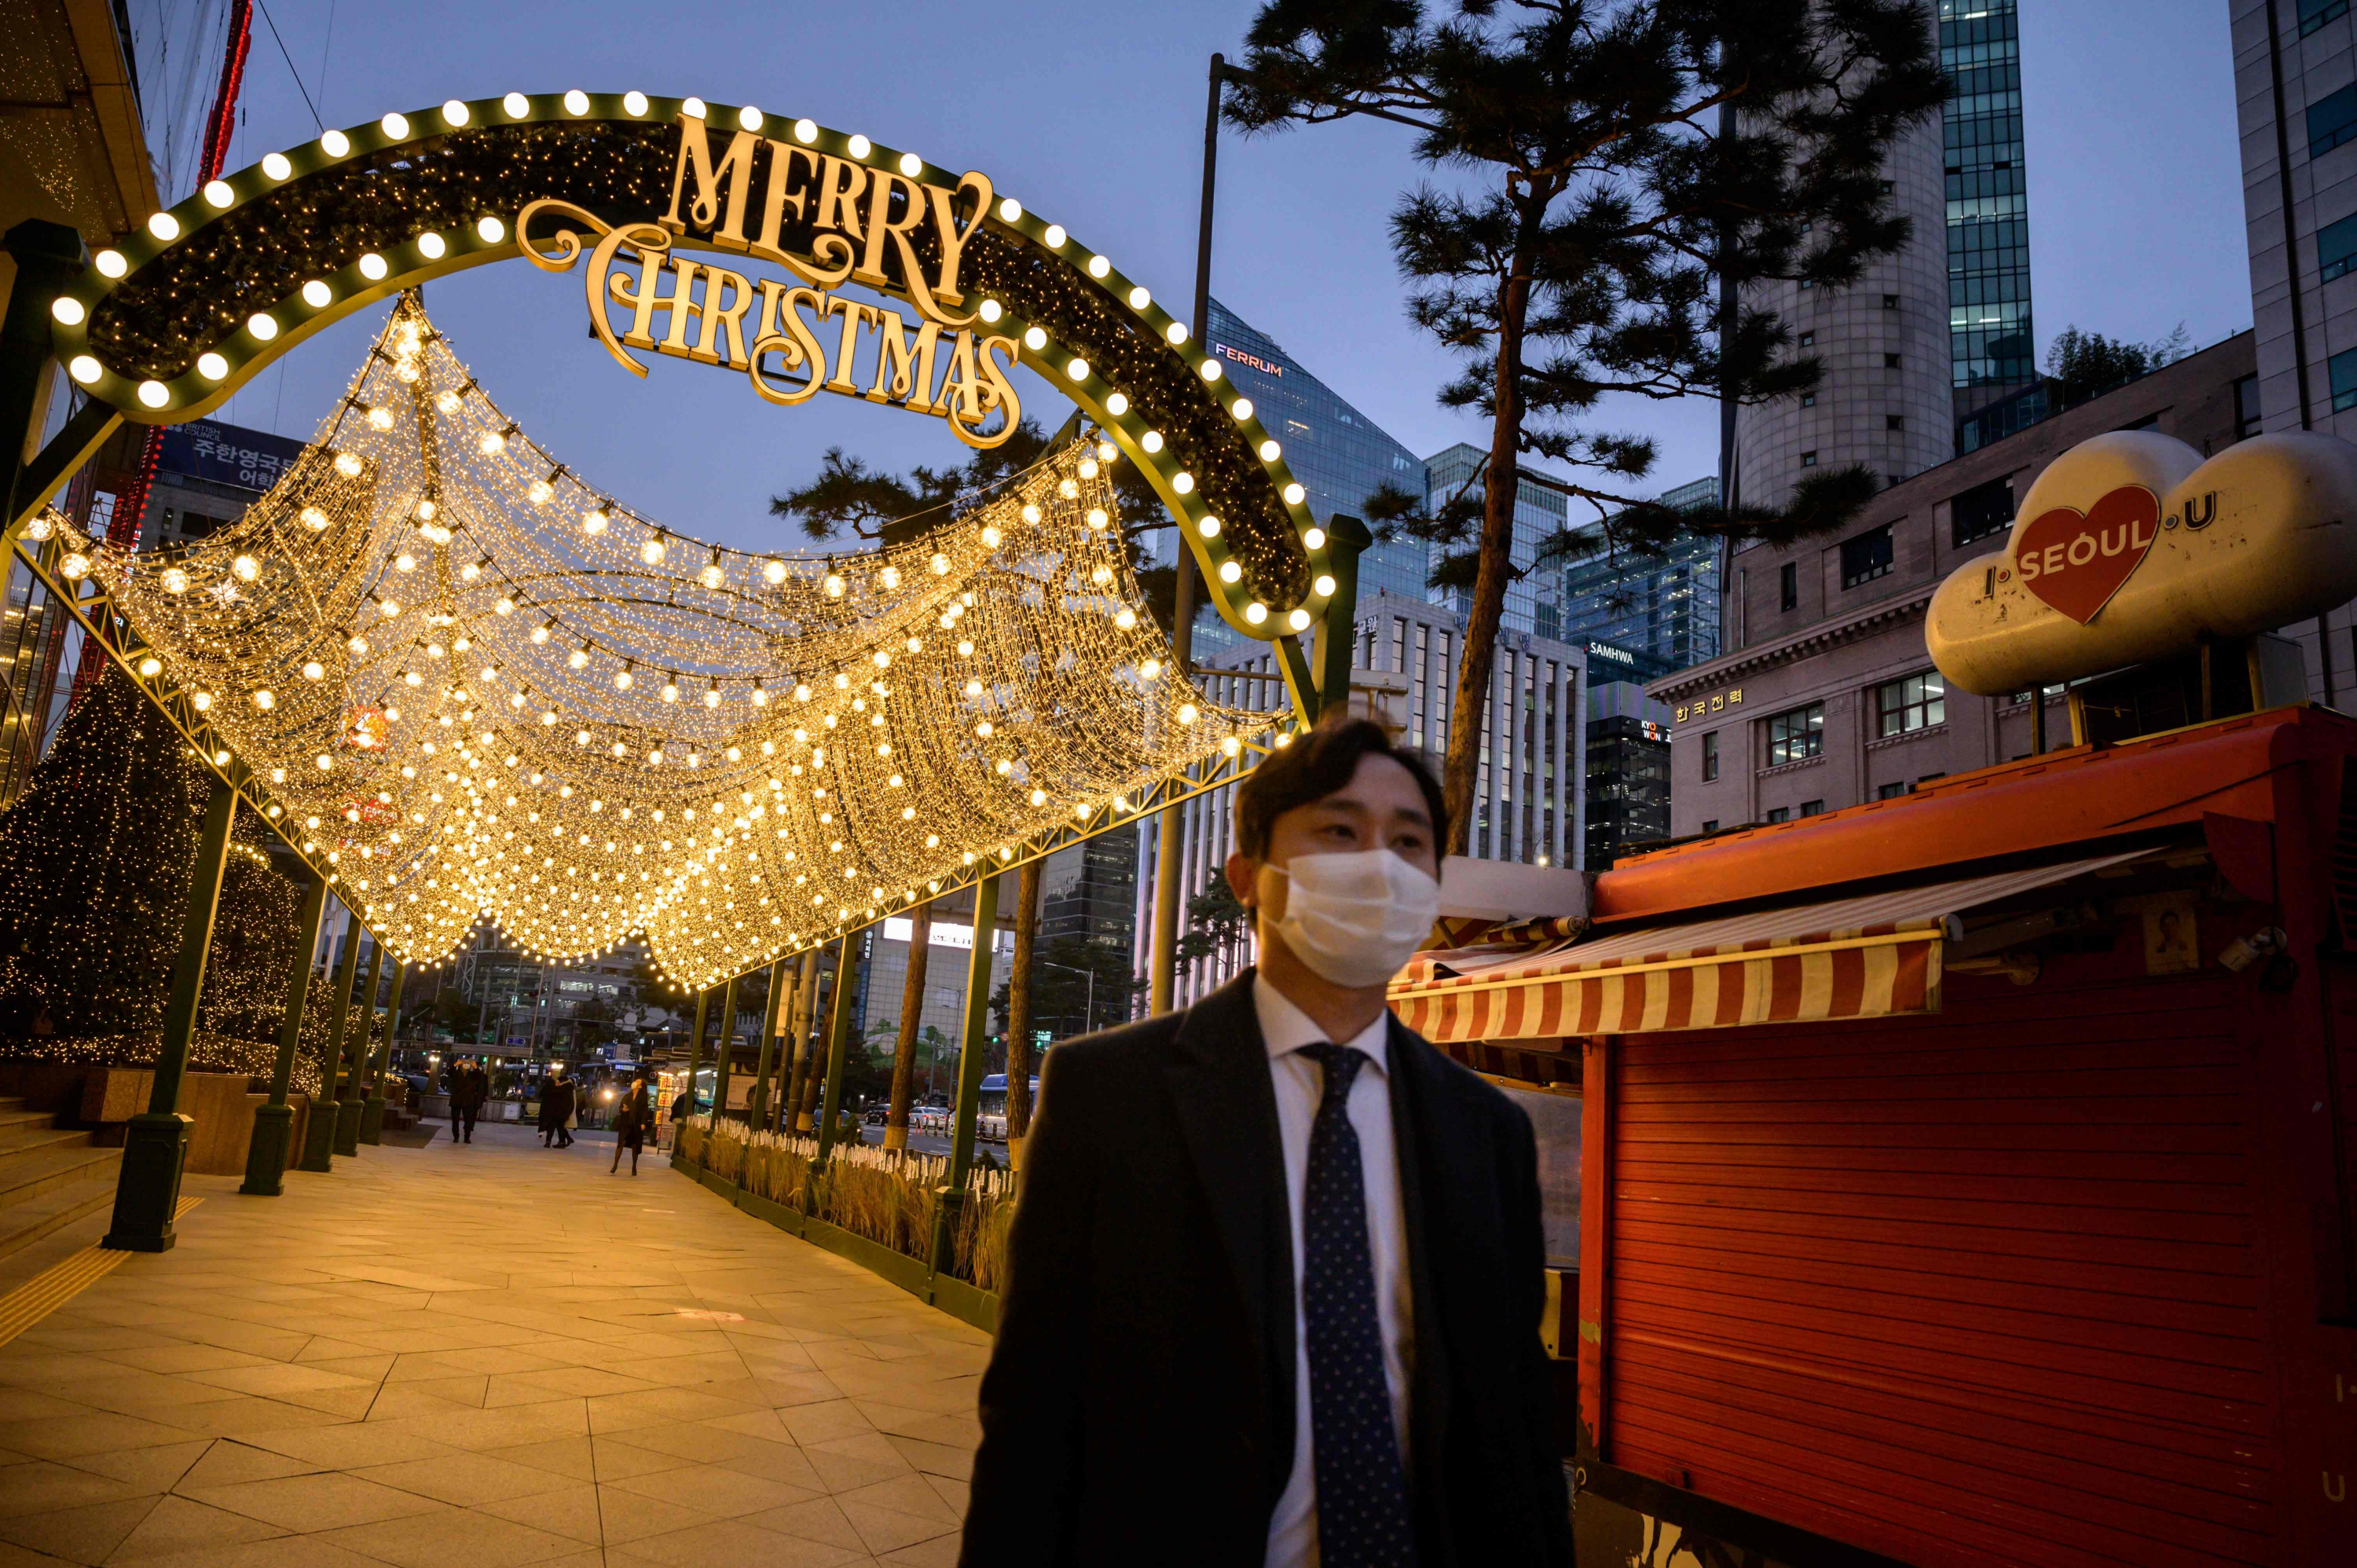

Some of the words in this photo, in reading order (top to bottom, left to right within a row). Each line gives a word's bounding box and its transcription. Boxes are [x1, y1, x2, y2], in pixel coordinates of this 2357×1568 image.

[658, 112, 993, 331] MERRY
[515, 200, 1021, 449] CHRISTMAS
[1215, 343, 1281, 377] FERRUM
[184, 429, 221, 442] COUNCIL
[185, 422, 221, 435] BRITISH
[2020, 519, 2153, 581] SEOUL
[1357, 615, 1378, 637] 교원
[1590, 642, 1634, 665] SAMHWA
[1676, 688, 1743, 723] 한국전력
[1641, 720, 1657, 731] KYO
[1643, 729, 1661, 742] WON
